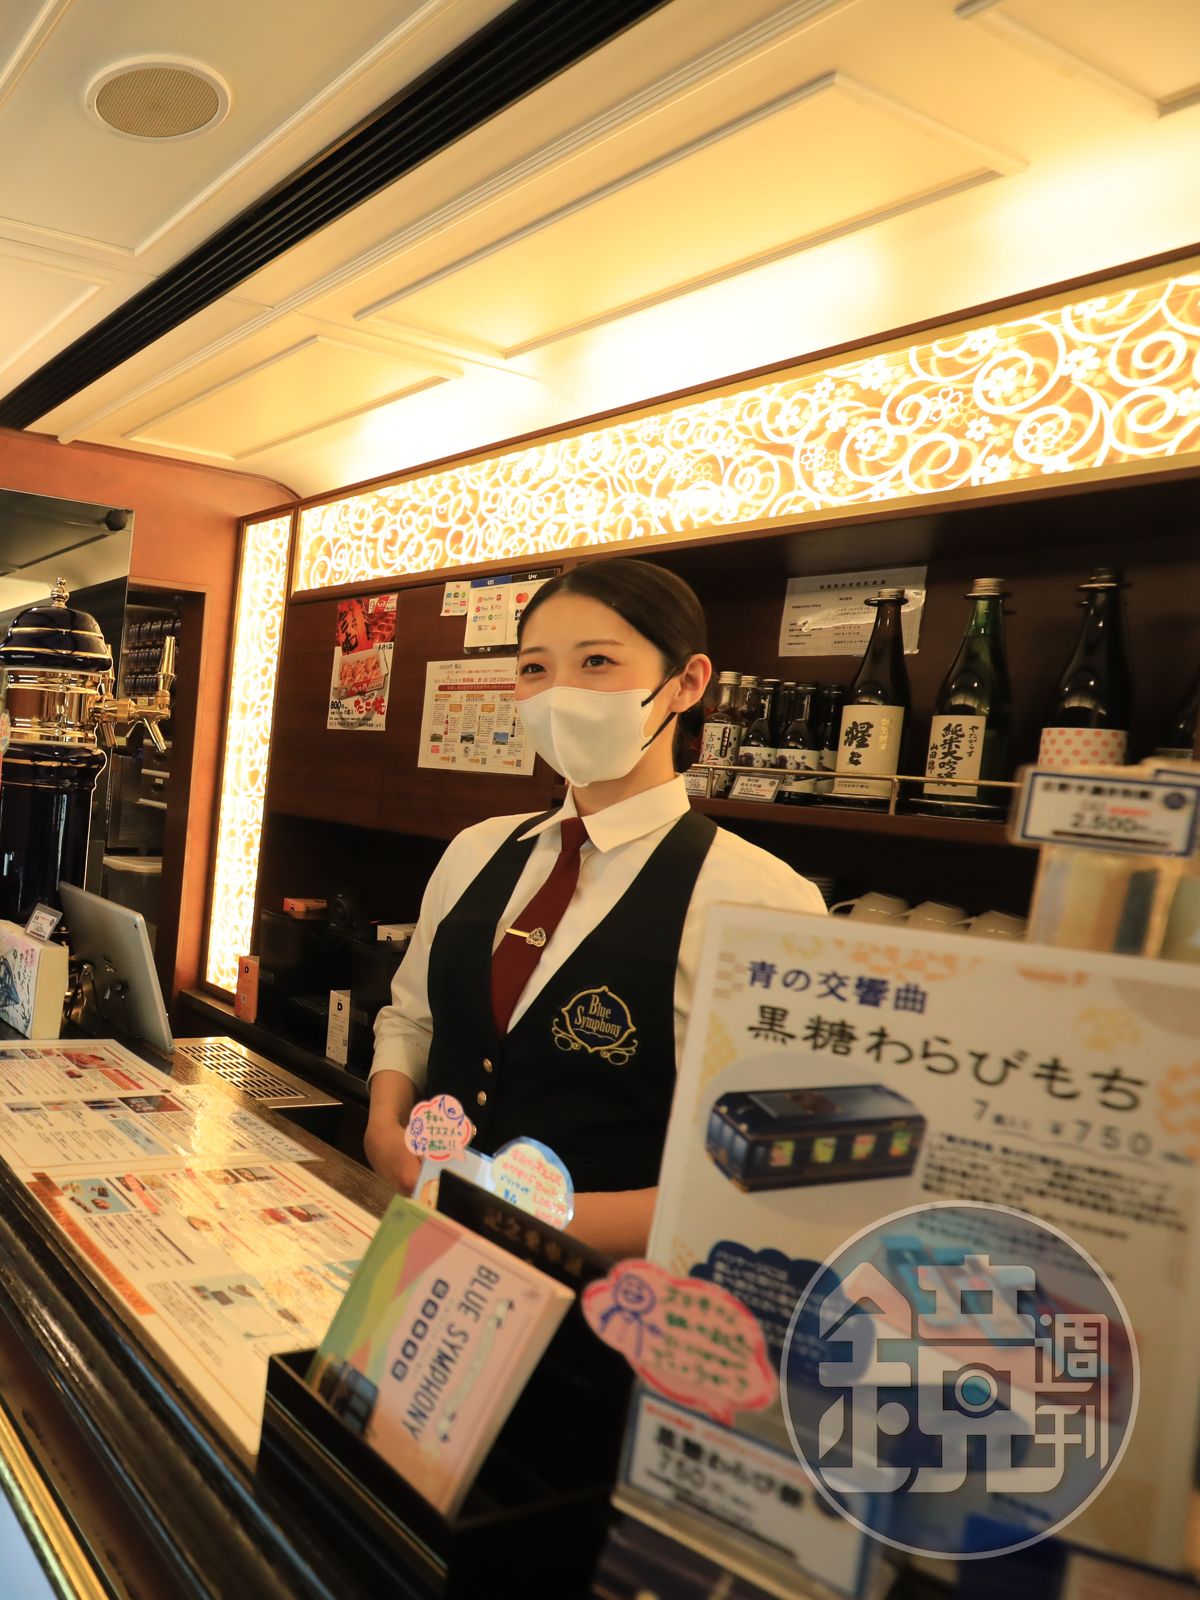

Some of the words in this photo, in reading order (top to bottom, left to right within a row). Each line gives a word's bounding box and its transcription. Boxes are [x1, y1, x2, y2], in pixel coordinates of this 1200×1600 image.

[588, 994, 612, 1018] Blue
[746, 960, 928, 1015] 青の交響曲
[574, 1005, 622, 1038] Symphony
[747, 1004, 1148, 1113] 黒糖わらびもち
[461, 1264, 500, 1323] BLUE
[402, 1323, 469, 1441] SYMPHONY
